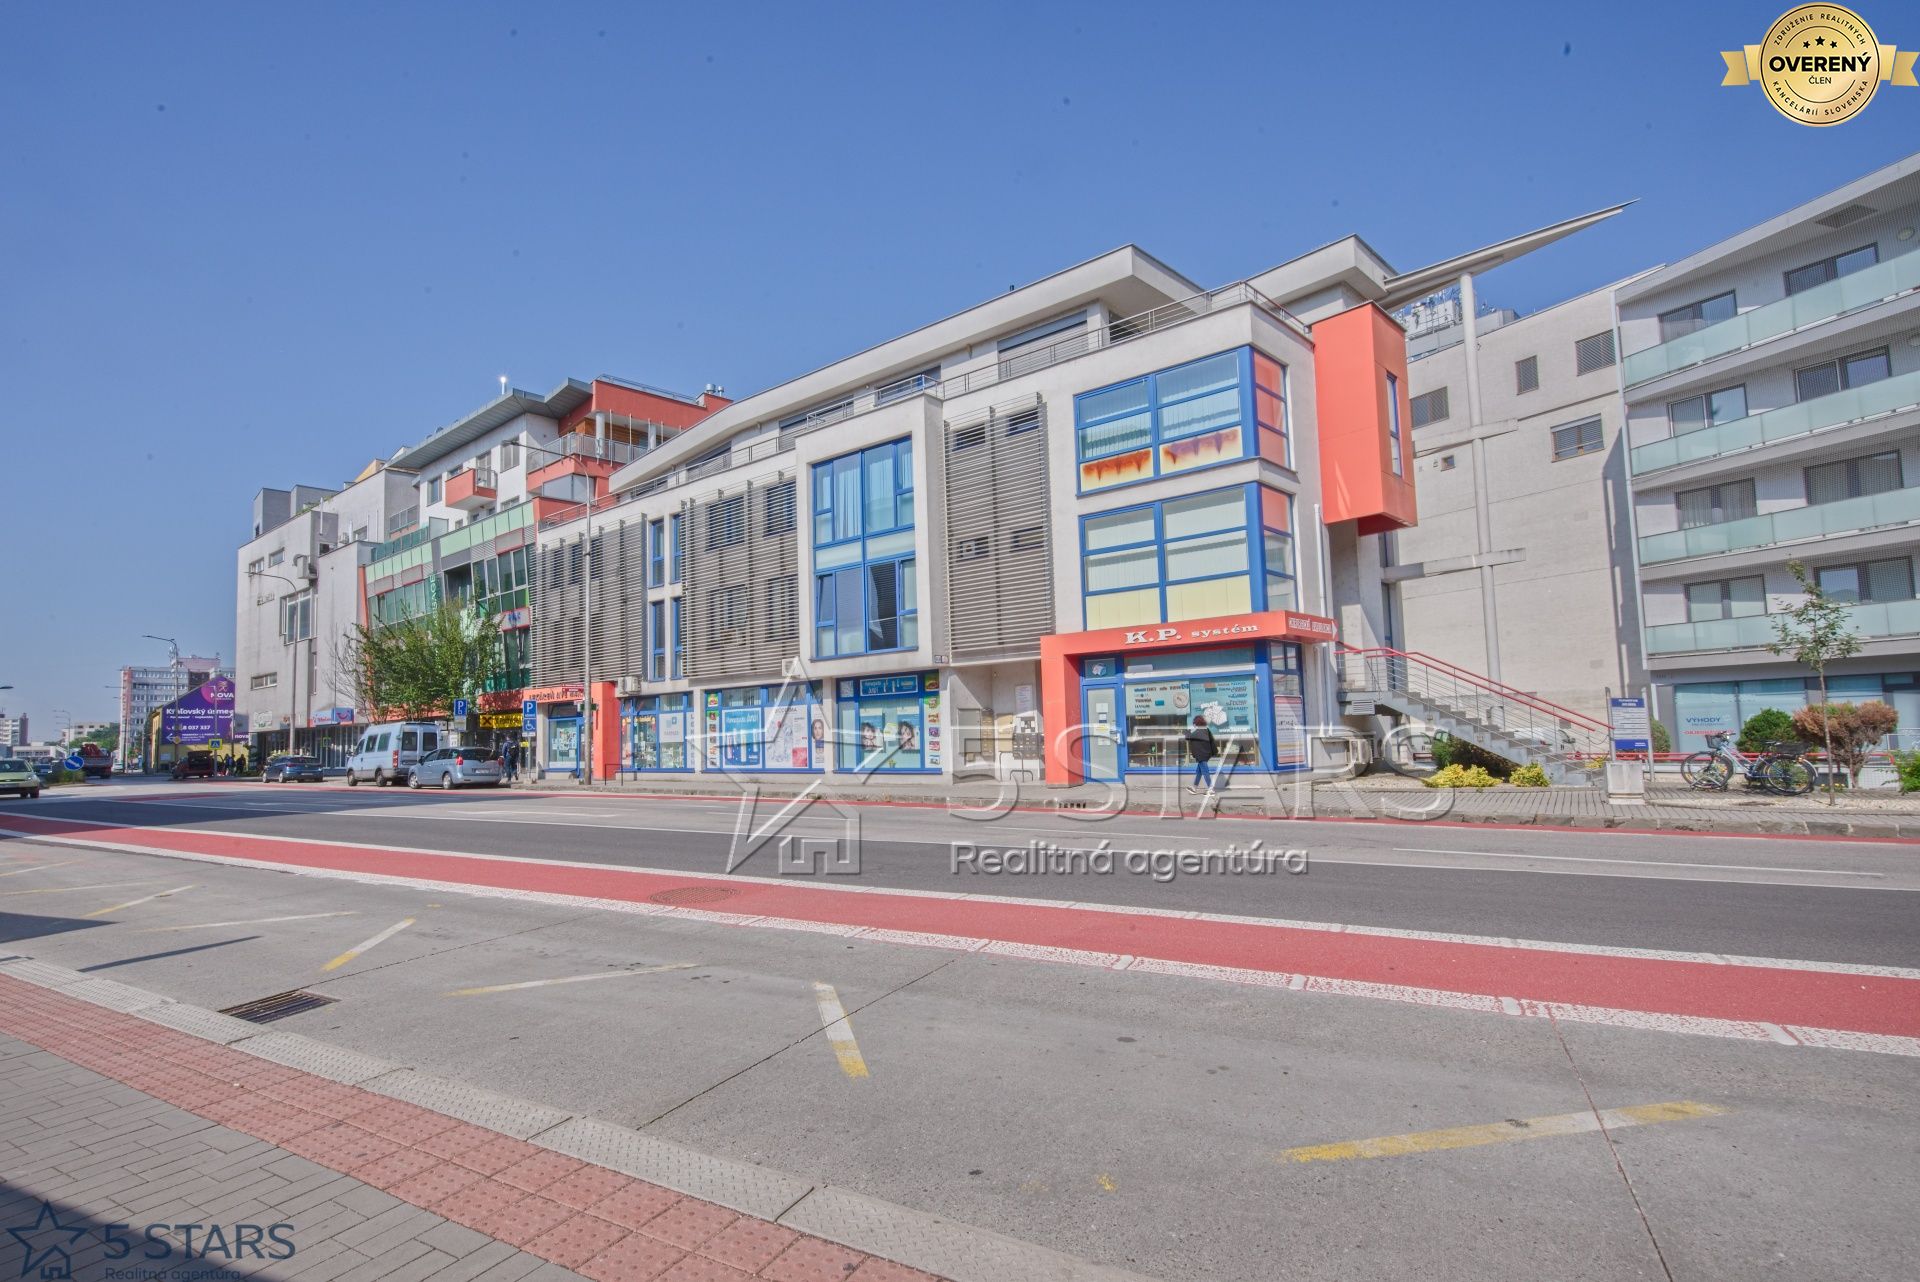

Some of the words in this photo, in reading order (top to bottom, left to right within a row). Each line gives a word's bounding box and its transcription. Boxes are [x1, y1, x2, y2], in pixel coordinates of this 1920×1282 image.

[1124, 628, 1182, 644] K.P.
[1191, 623, 1259, 638] systém
[526, 702, 533, 713] P
